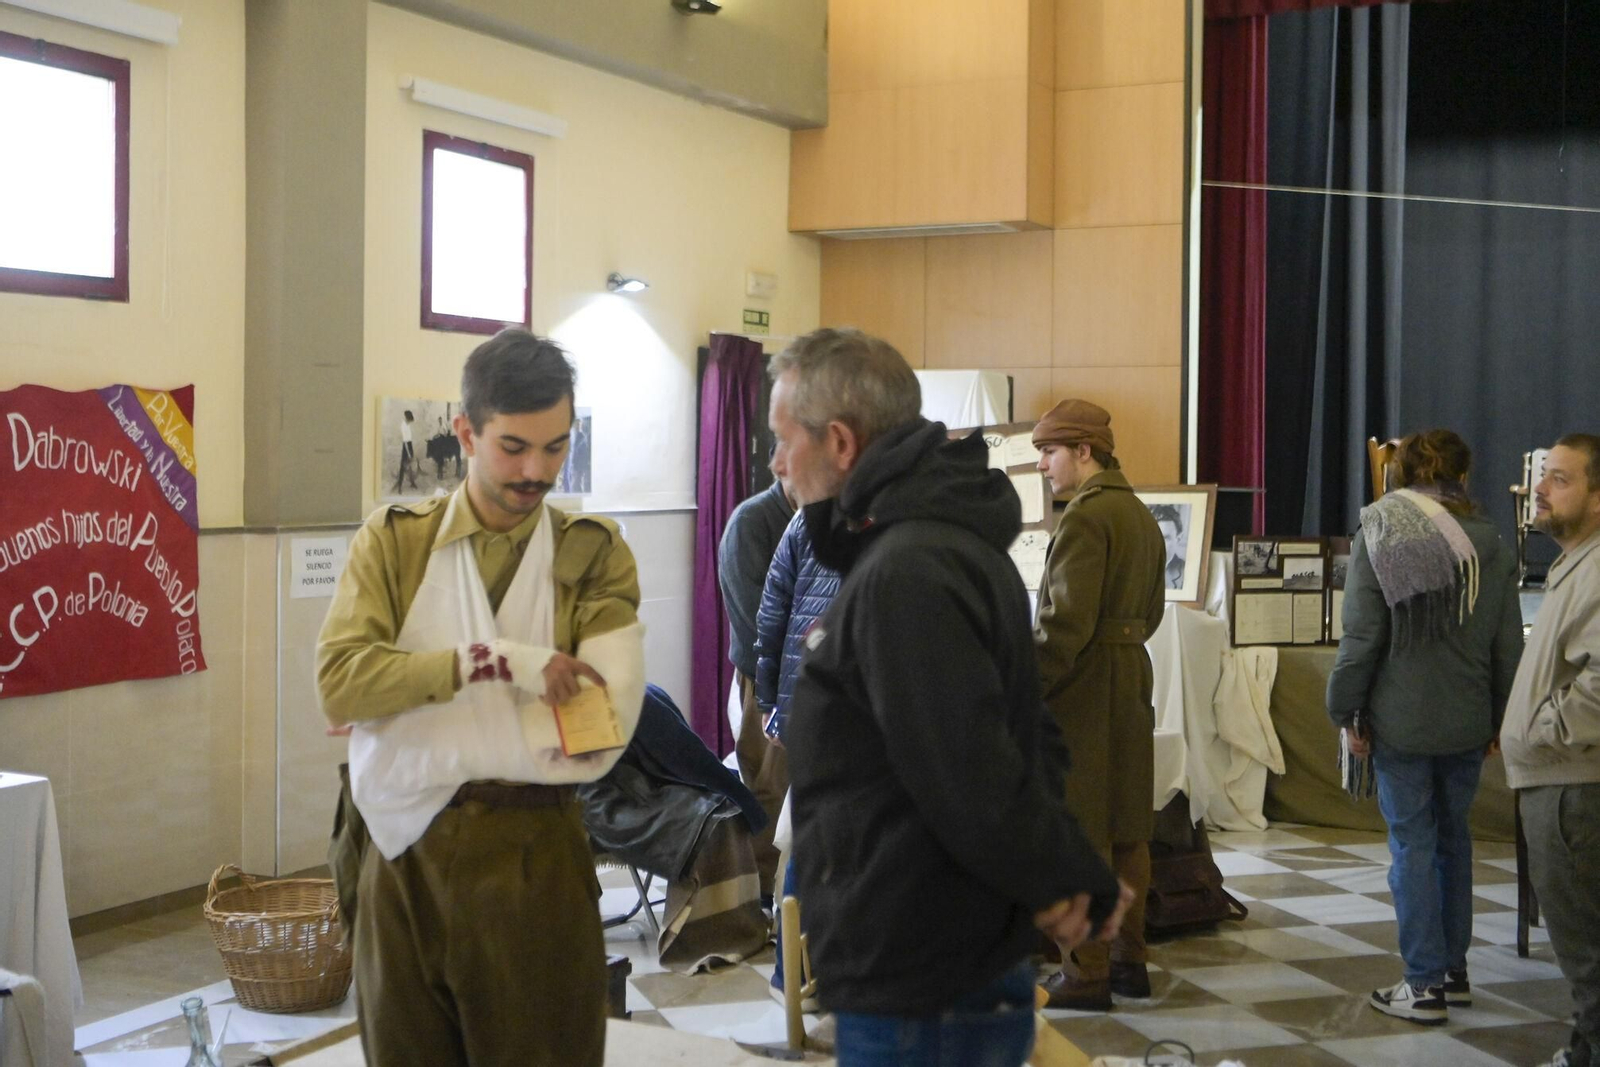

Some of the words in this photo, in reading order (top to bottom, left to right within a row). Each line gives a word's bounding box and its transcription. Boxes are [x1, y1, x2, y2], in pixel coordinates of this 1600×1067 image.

[6, 412, 143, 492] Dabrowski
[107, 385, 144, 442] Libertad
[140, 438, 149, 450] y
[150, 451, 188, 512] Nuestra
[146, 392, 168, 427] Por
[163, 411, 194, 470] Vuestra
[302, 577, 314, 586] POR
[315, 576, 336, 585] FAVOR
[305, 549, 312, 557] SE
[313, 548, 334, 557] RUEGA
[306, 562, 332, 571] SILENCIO
[62, 508, 103, 549] hijos
[106, 511, 133, 546] del
[130, 511, 183, 604] Pueblo
[171, 589, 197, 675] Polaco
[65, 591, 85, 616] de
[88, 572, 149, 628] Polonia
